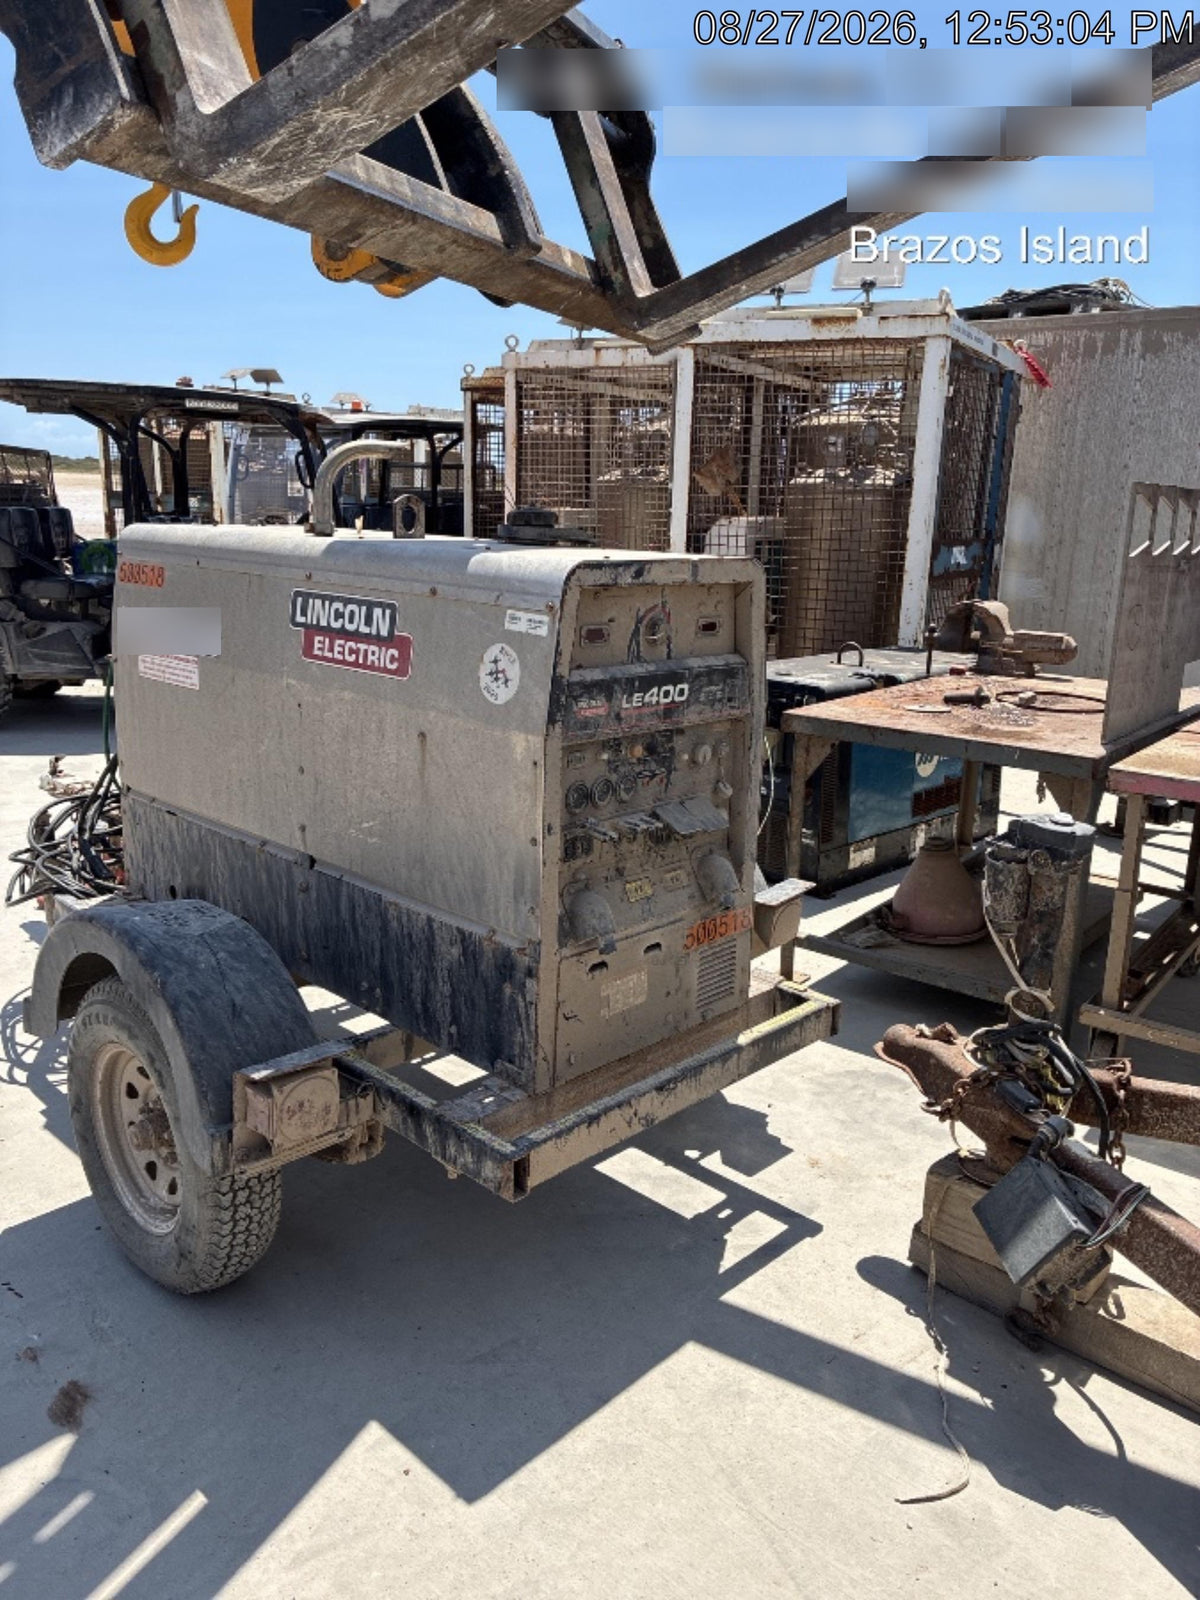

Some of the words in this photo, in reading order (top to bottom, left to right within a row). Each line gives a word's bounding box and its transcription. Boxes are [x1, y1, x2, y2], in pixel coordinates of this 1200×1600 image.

[294, 597, 391, 637] LINCOLN
[313, 636, 399, 670] ELECTRIC
[622, 685, 689, 708] LE400
